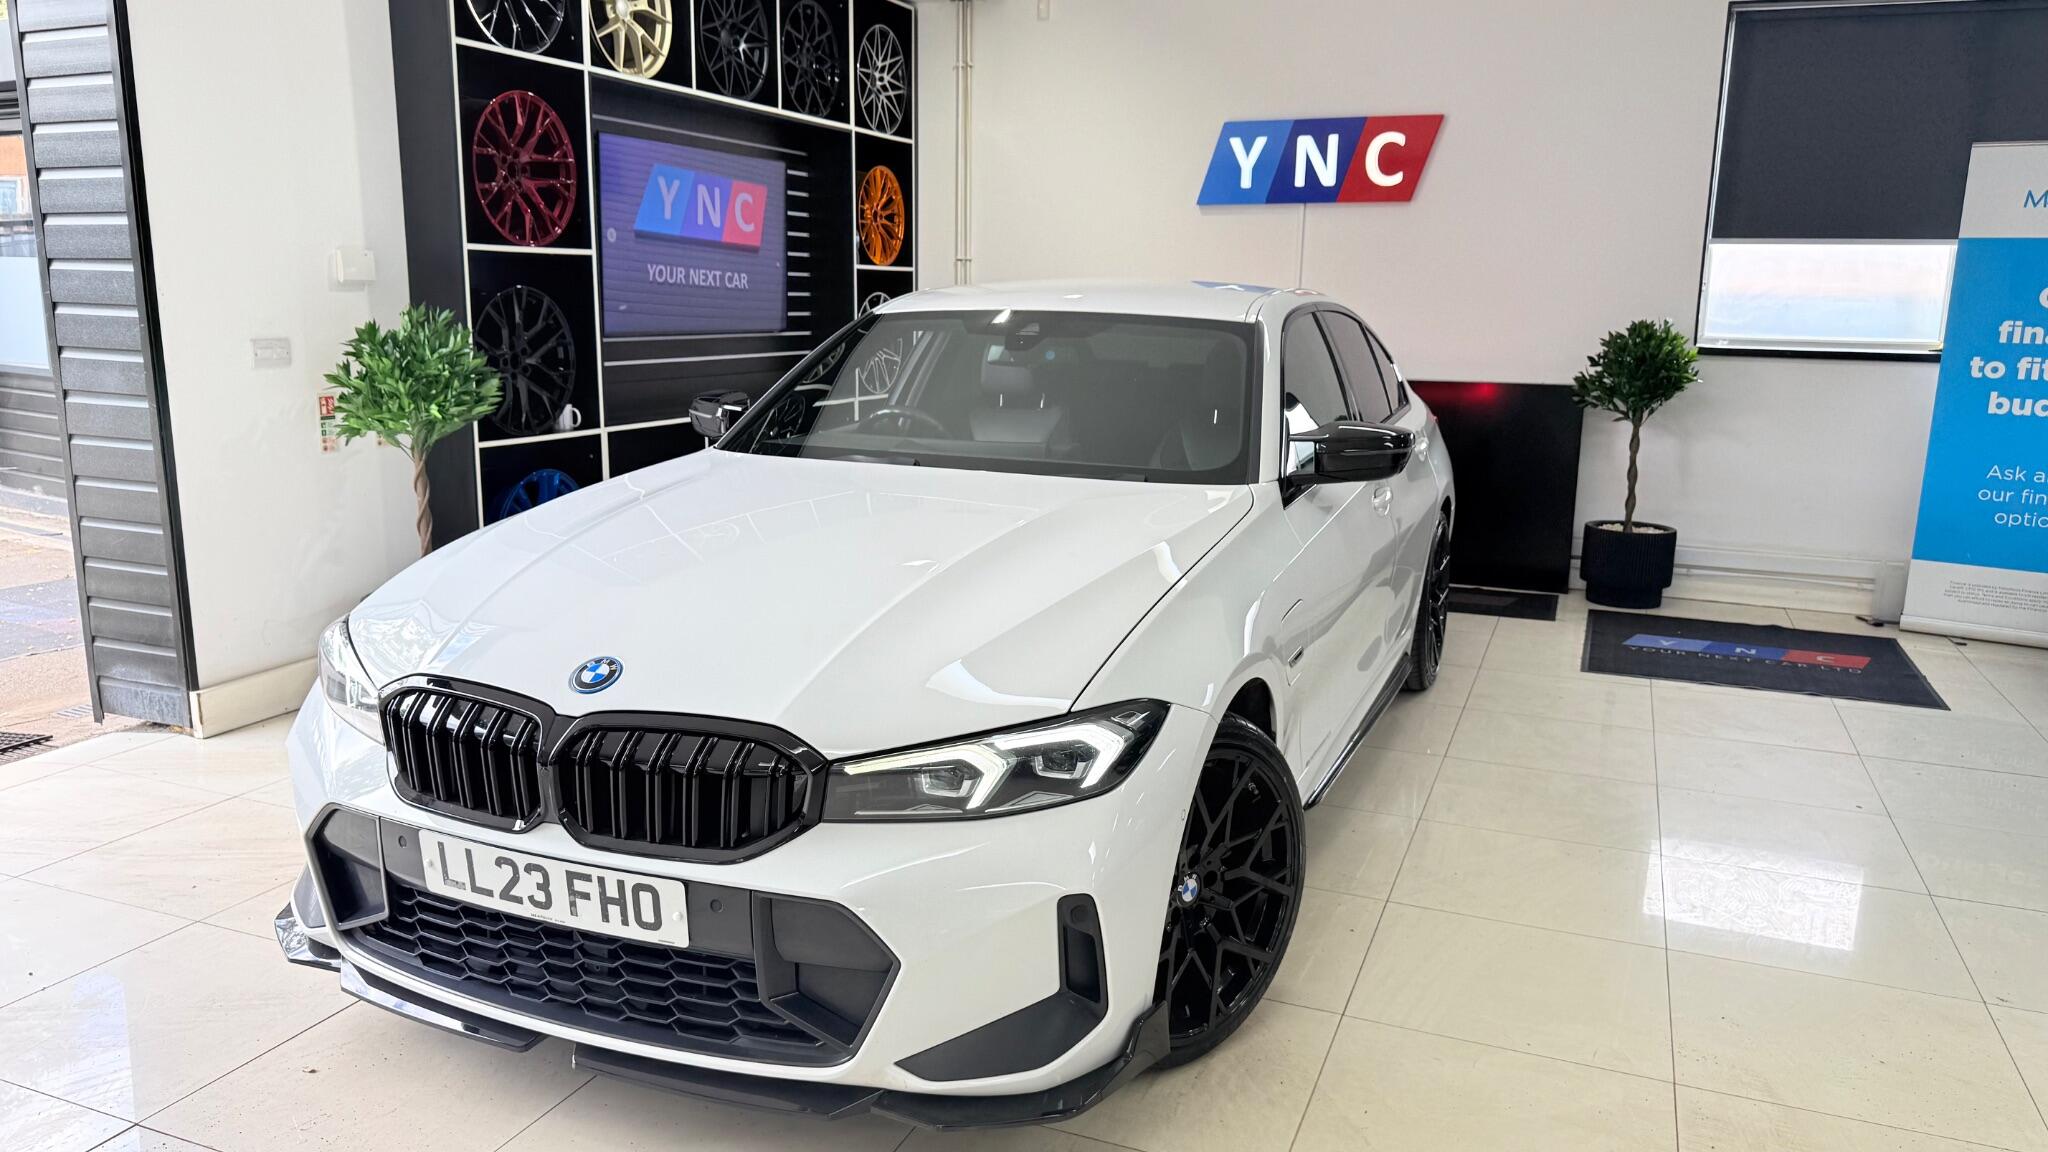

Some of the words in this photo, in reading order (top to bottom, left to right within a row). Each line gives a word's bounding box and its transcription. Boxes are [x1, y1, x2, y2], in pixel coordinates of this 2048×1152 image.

[1229, 131, 1406, 189] YNC
[657, 175, 755, 233] YNC
[647, 264, 686, 284] YOUR
[689, 268, 722, 287] NEXT
[725, 271, 749, 289] CAR
[1998, 320, 2048, 345] fin
[1970, 356, 2006, 379] to
[1986, 465, 2027, 482] Ask
[2033, 471, 2048, 483] a
[1978, 489, 2015, 503] our
[437, 841, 553, 911] LL23
[565, 869, 663, 932] FHO
